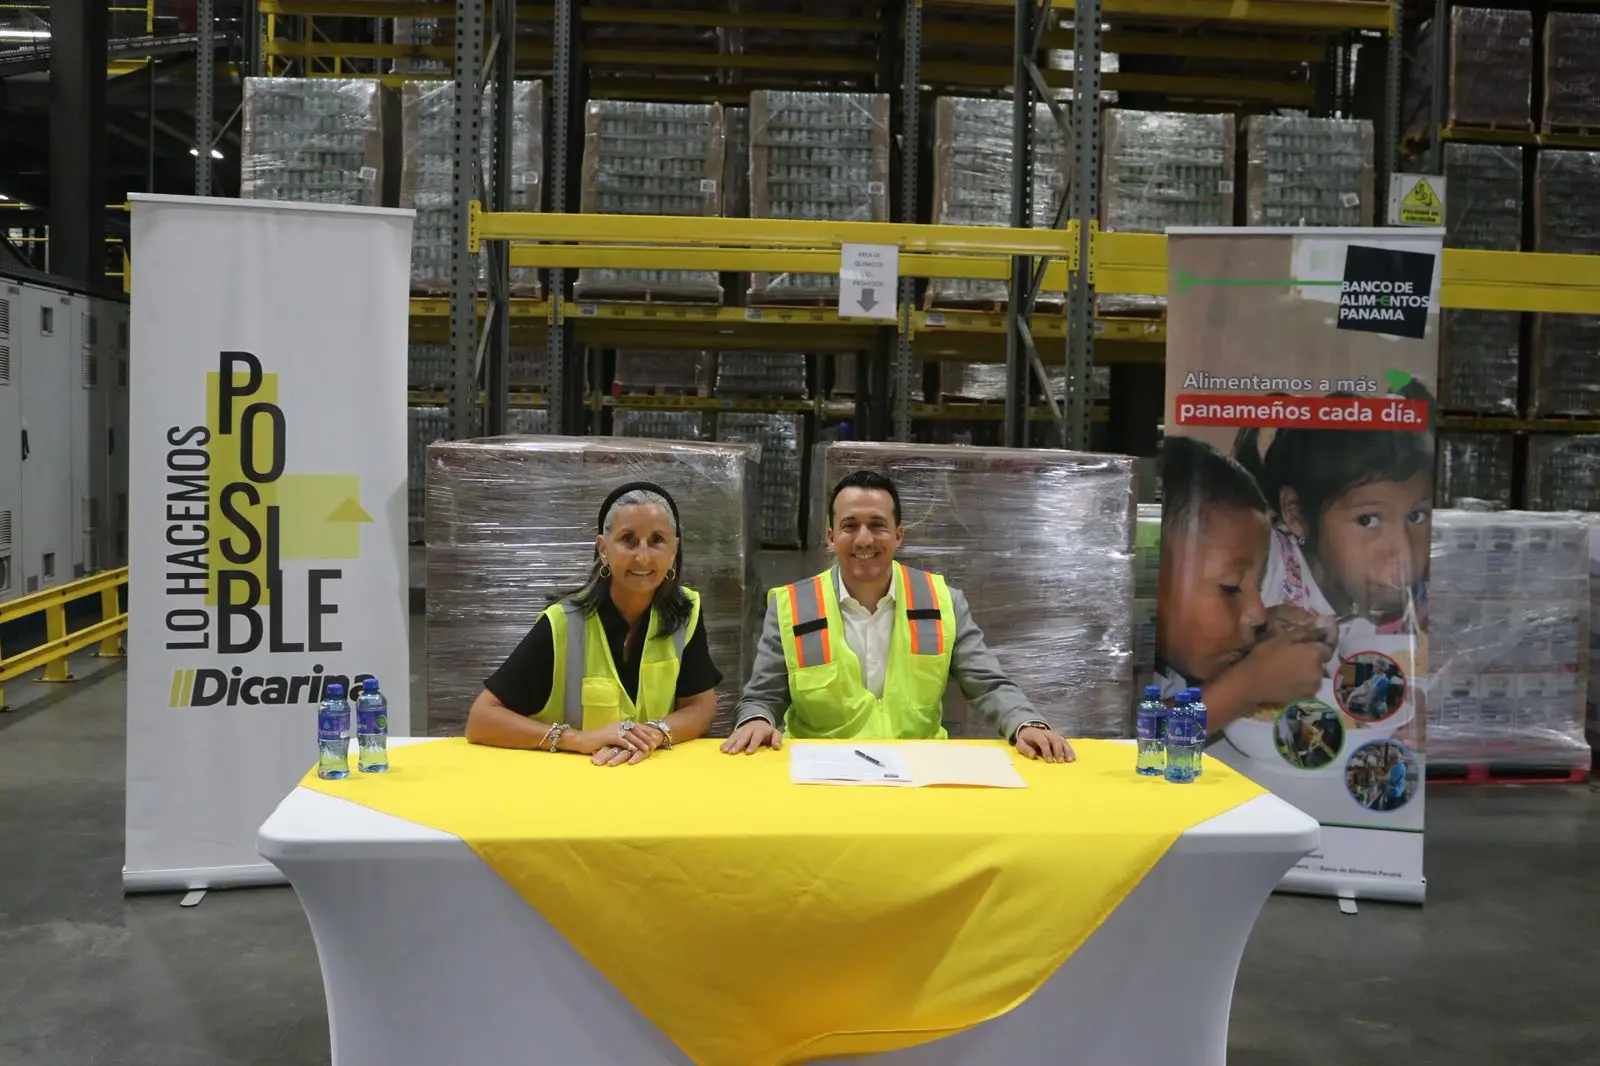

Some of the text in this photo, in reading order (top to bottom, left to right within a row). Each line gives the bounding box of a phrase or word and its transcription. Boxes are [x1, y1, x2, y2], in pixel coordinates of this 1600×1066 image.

[1341, 281, 1414, 294] BANCO DE
[1340, 294, 1430, 308] ALIMENTOS
[1340, 308, 1405, 321] PANAMA
[1183, 372, 1377, 393] Alimentamos a más
[1180, 401, 1423, 424] panameños cada día.
[165, 425, 211, 650] LO HACEMOS
